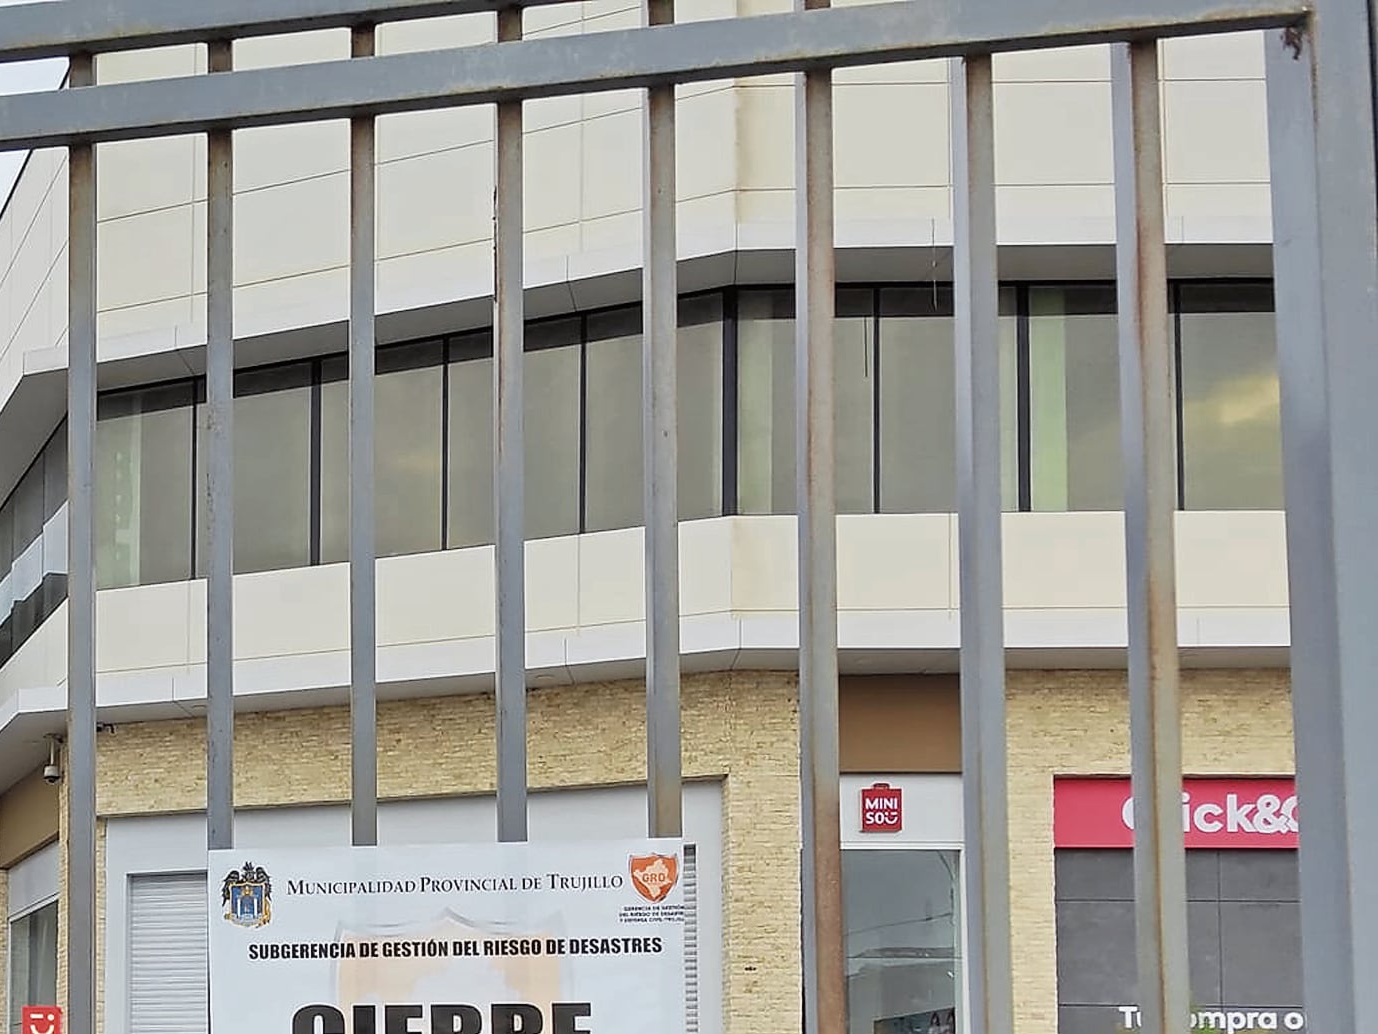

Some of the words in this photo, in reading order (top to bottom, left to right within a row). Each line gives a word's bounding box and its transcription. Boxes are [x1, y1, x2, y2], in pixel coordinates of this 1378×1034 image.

[865, 798, 898, 810] MINI
[249, 941, 356, 960] SUBGERENCIA
[359, 942, 379, 959] DE
[381, 938, 449, 958] GESTIÓN
[452, 940, 482, 957] DEL
[483, 939, 542, 956] RIESGO
[545, 938, 566, 955] DE
[569, 937, 663, 956] DESASTRES
